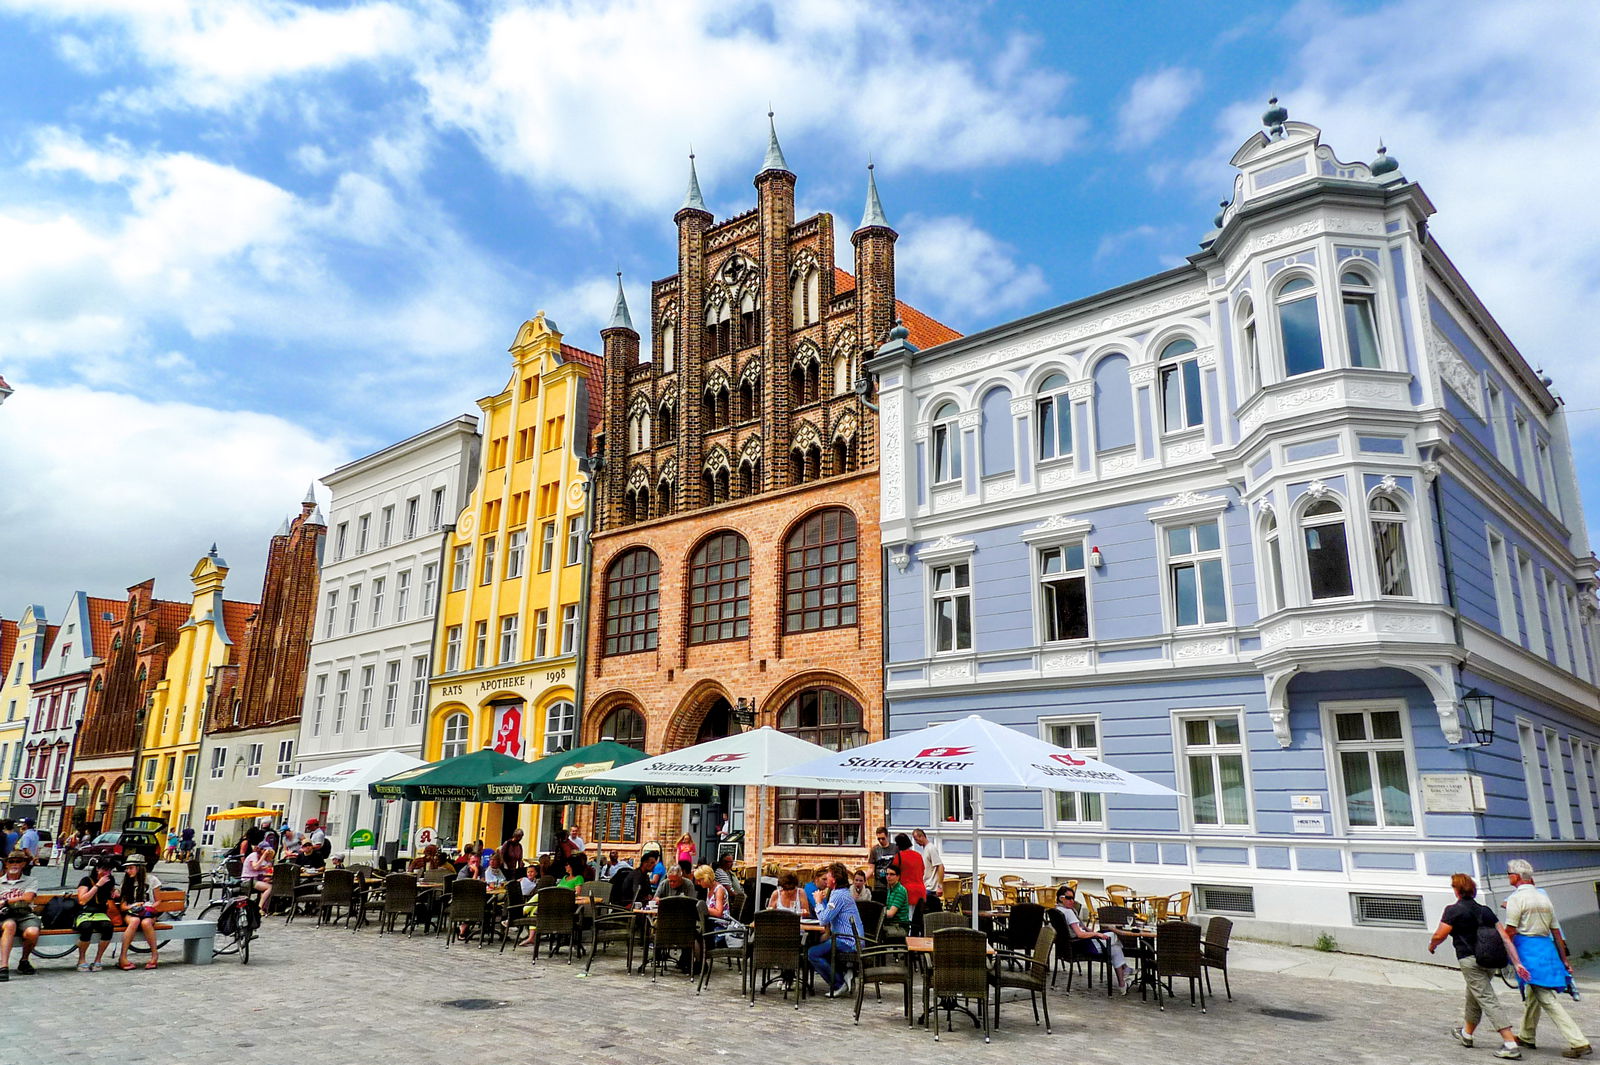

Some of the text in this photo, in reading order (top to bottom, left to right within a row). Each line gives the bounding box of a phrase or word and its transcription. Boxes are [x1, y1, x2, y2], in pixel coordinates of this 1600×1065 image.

[442, 668, 566, 697] RATS APOTHEKE 1998
[643, 761, 741, 774] Störtebeker
[839, 756, 976, 772] Störtebeker
[23, 787, 33, 795] 30
[487, 783, 523, 796] WERNESGRÜNER
[547, 782, 617, 797] WERNESGRÜNER
[645, 784, 699, 797] WERNESGRÜNER
